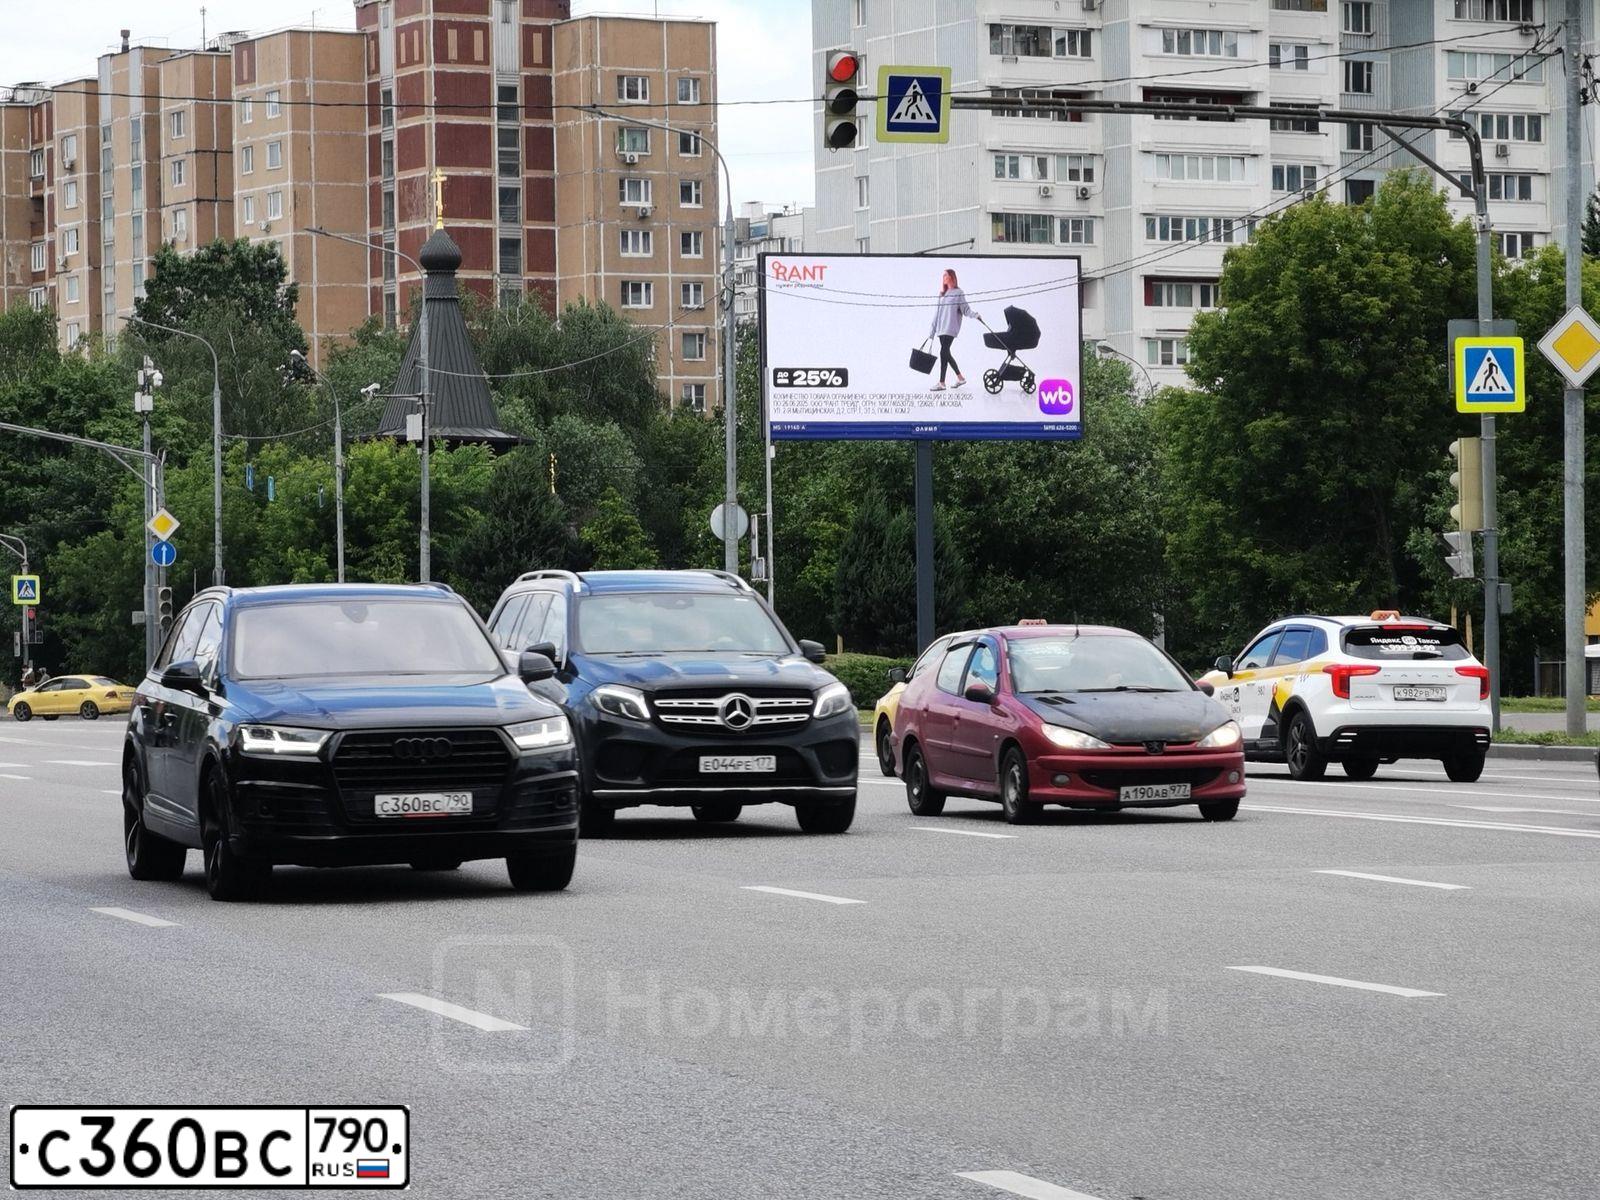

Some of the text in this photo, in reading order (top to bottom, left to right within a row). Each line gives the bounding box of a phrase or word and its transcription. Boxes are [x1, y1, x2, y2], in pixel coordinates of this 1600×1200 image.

[772, 261, 827, 281] RANT
[793, 370, 842, 386] 25%
[1041, 386, 1072, 404] wb
[704, 758, 752, 770] Е044РЕ
[1124, 785, 1187, 799] А190АВ 977
[381, 795, 469, 812] С360ВС 790
